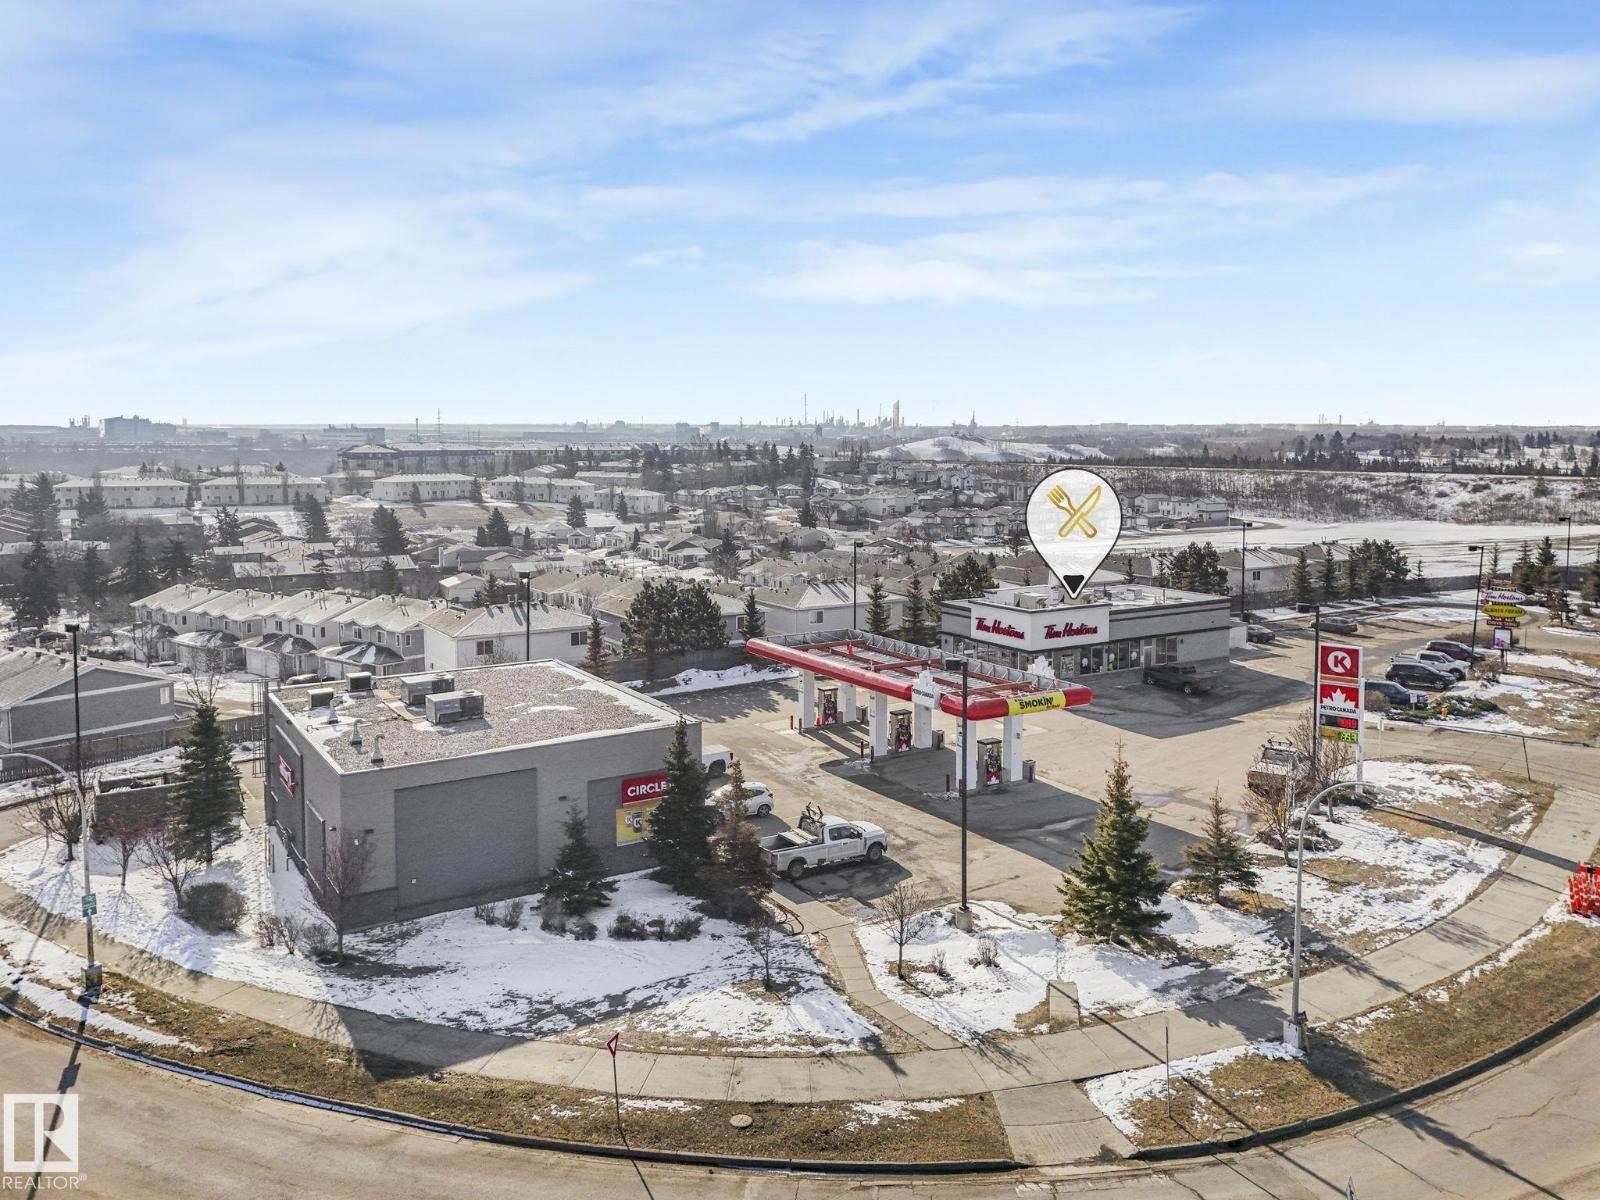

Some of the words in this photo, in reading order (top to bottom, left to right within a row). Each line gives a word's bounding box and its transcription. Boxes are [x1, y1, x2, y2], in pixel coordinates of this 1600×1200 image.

[975, 617, 991, 632] Tim
[991, 619, 1025, 640] Hortons
[1044, 624, 1062, 639] Tim
[1062, 622, 1098, 638] Hortons
[627, 781, 667, 797] CIRCLE
